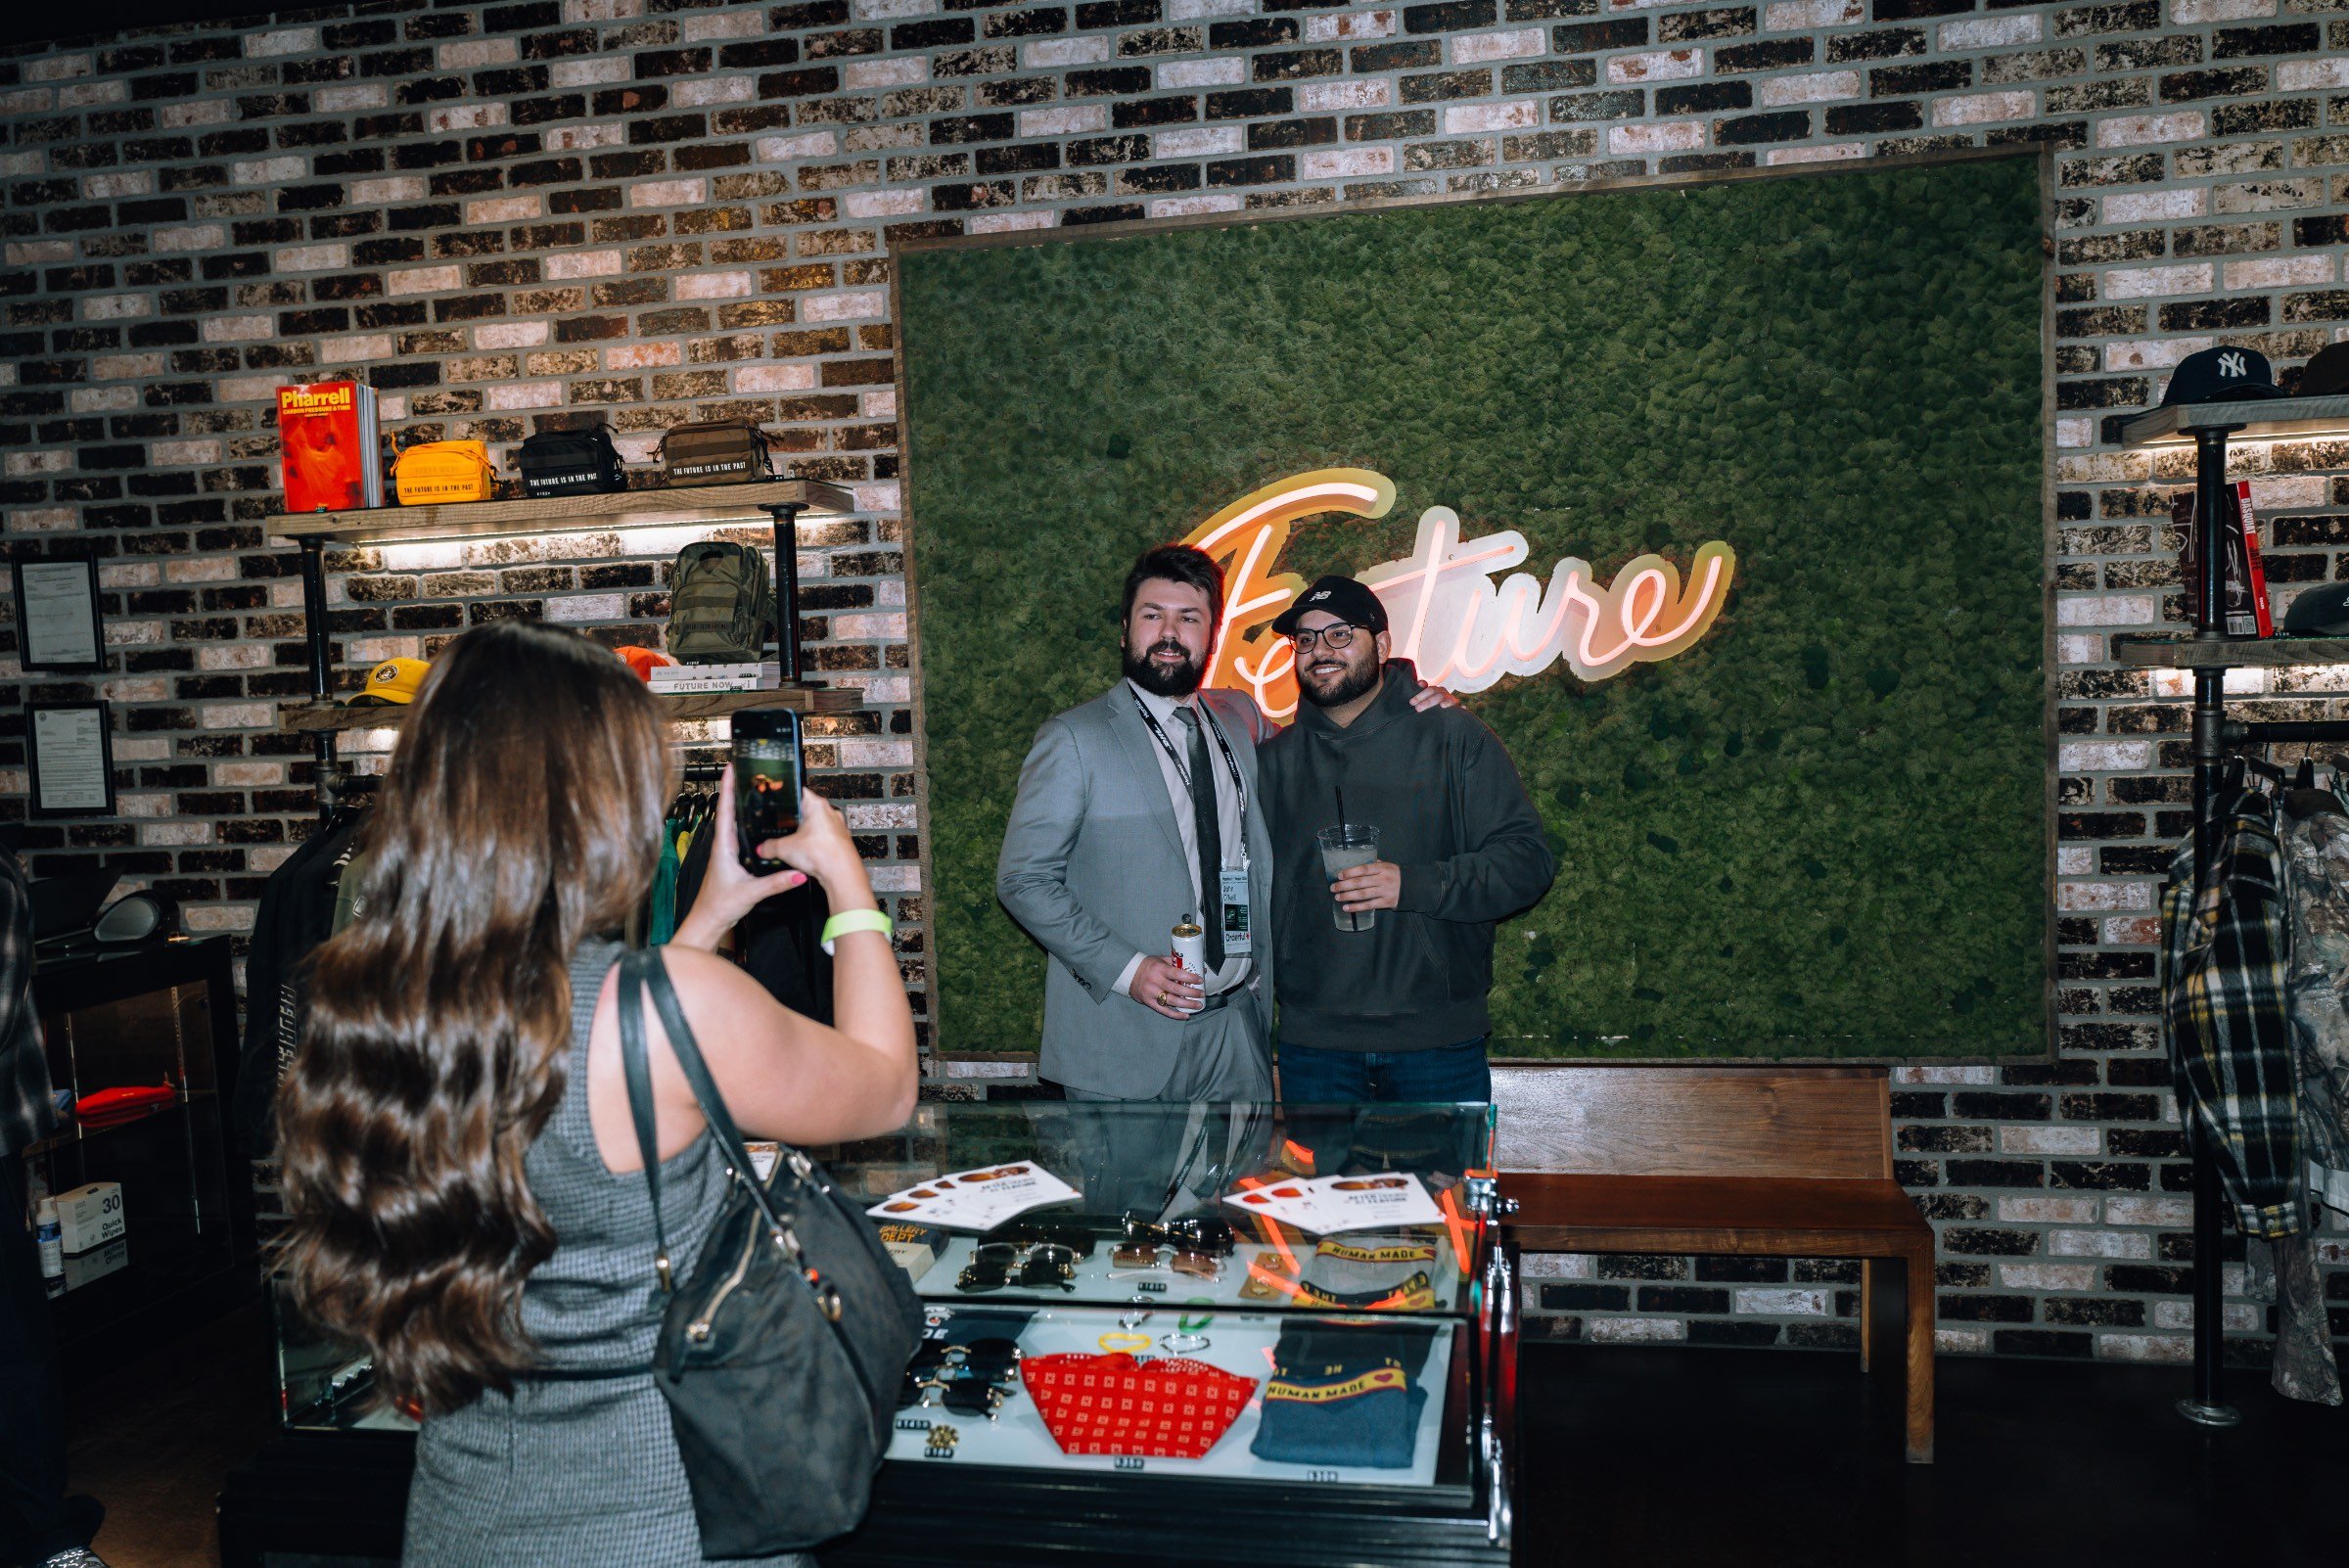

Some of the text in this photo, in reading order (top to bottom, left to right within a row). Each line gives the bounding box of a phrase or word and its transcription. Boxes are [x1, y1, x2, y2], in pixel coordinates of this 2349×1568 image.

[2217, 351, 2247, 378] NY
[281, 387, 350, 408] Pharrell
[683, 466, 704, 475] FUTURE
[732, 461, 746, 470] PAST
[540, 477, 560, 485] FUTURE
[2240, 497, 2256, 534] BASQUIAT
[2248, 547, 2262, 572] JAFFE
[1186, 473, 1729, 720] Feture
[673, 681, 709, 691] FUTURE
[712, 681, 733, 690] NOW
[103, 1194, 120, 1214] 30
[102, 1218, 122, 1230] Quick
[879, 1224, 928, 1235] GALLERY
[101, 1226, 123, 1239] Wipes
[881, 1232, 916, 1243] DEPT
[1332, 1246, 1416, 1260] HUMAN MADE
[1267, 1382, 1365, 1400] HUMAN MADE
